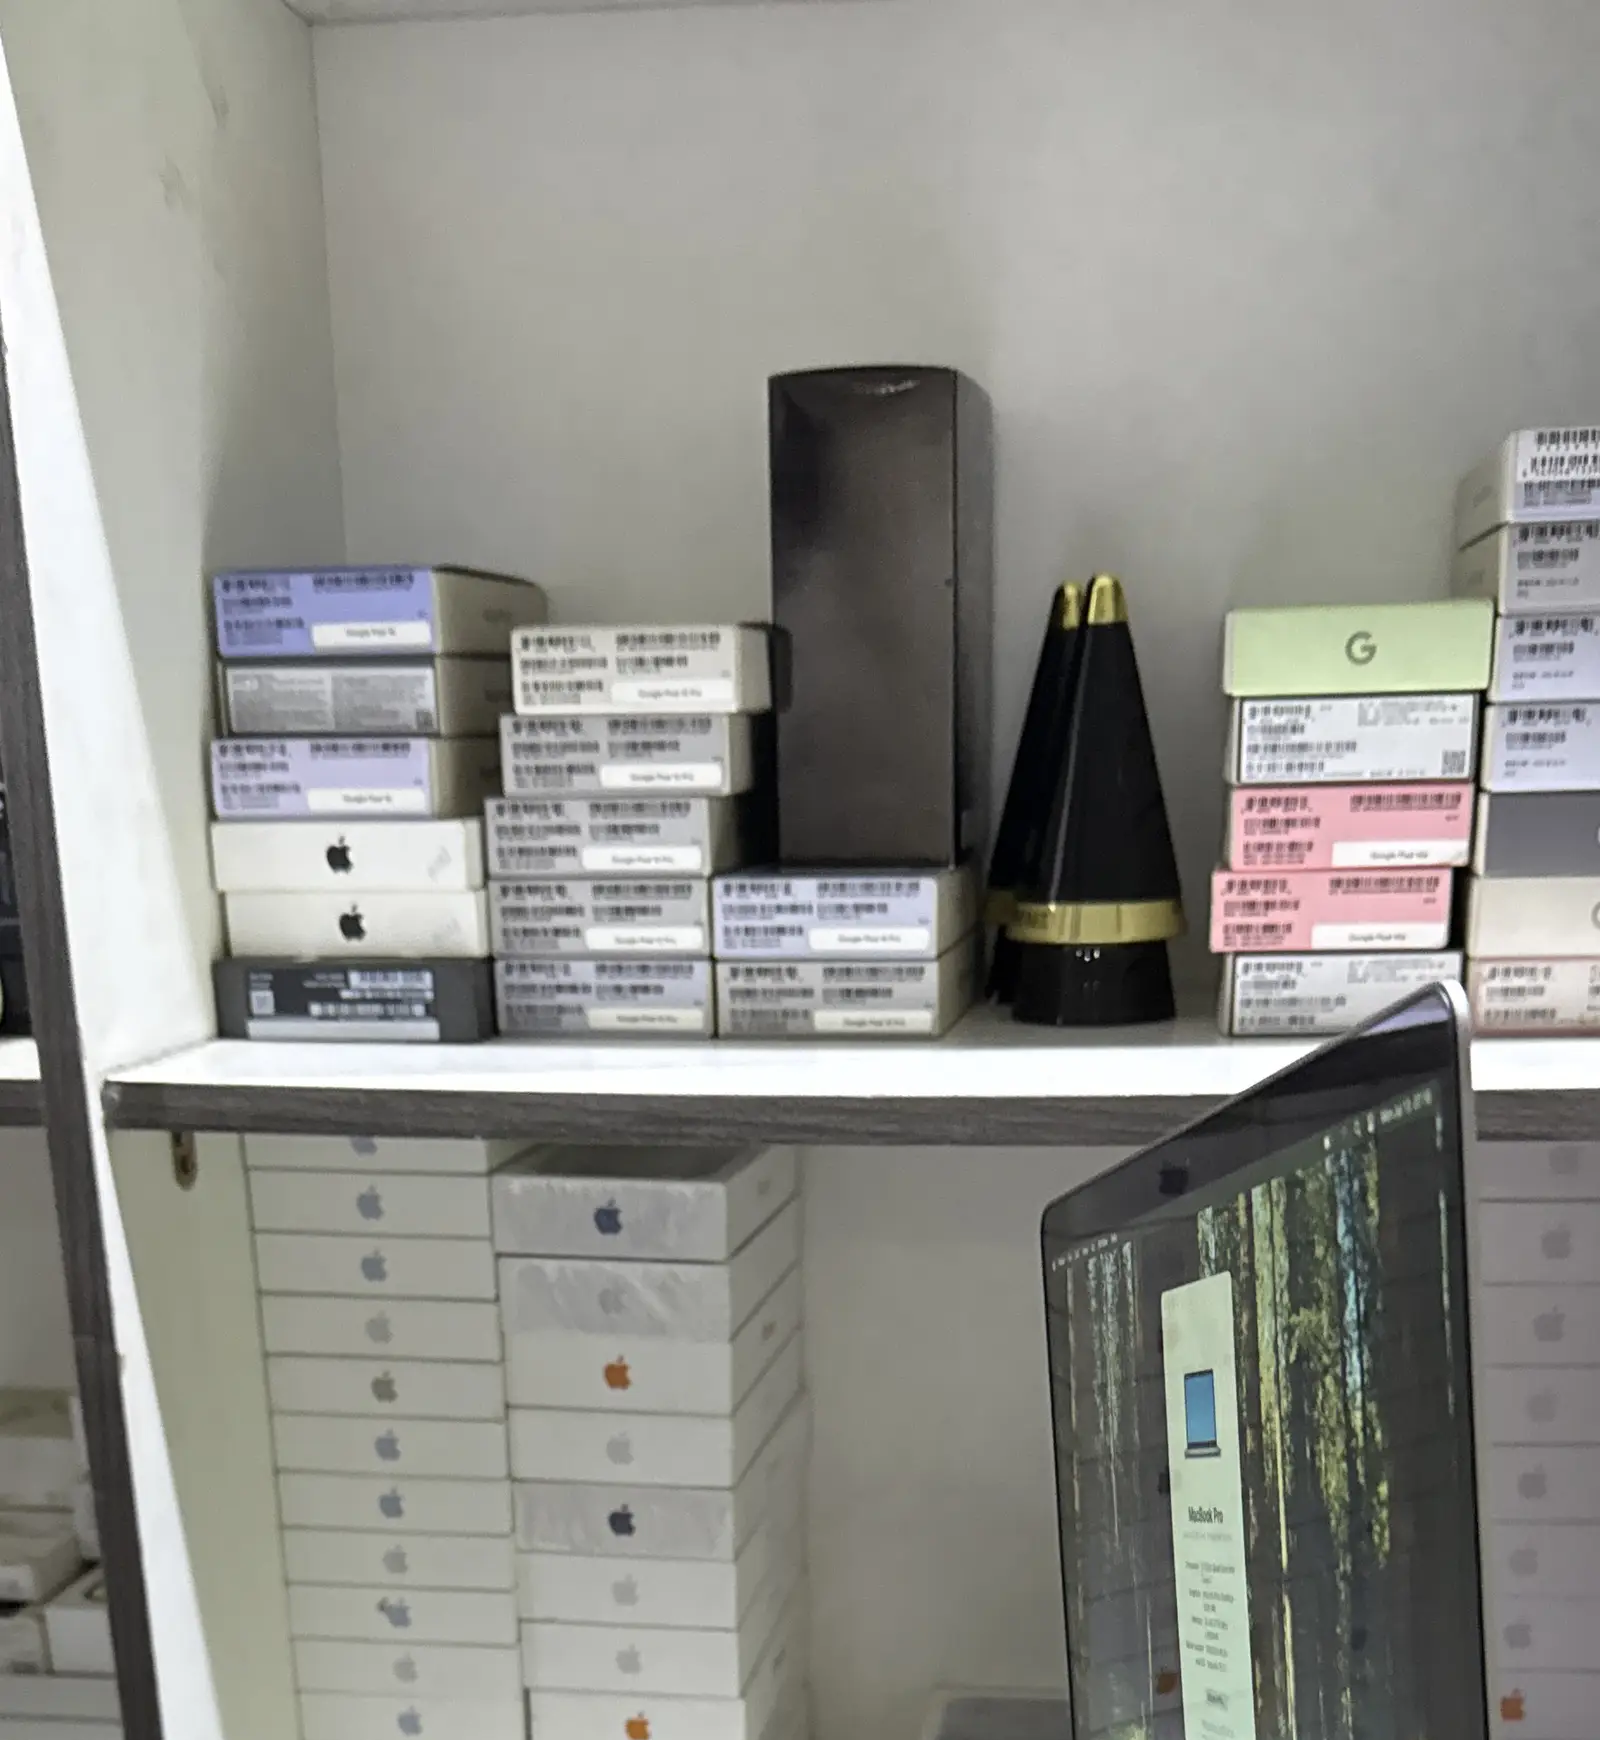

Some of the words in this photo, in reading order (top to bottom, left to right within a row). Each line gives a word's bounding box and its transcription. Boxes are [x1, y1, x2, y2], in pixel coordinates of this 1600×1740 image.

[1345, 630, 1377, 665] G
[1187, 1505, 1212, 1524] MacBook
[1213, 1506, 1224, 1525] Pro
